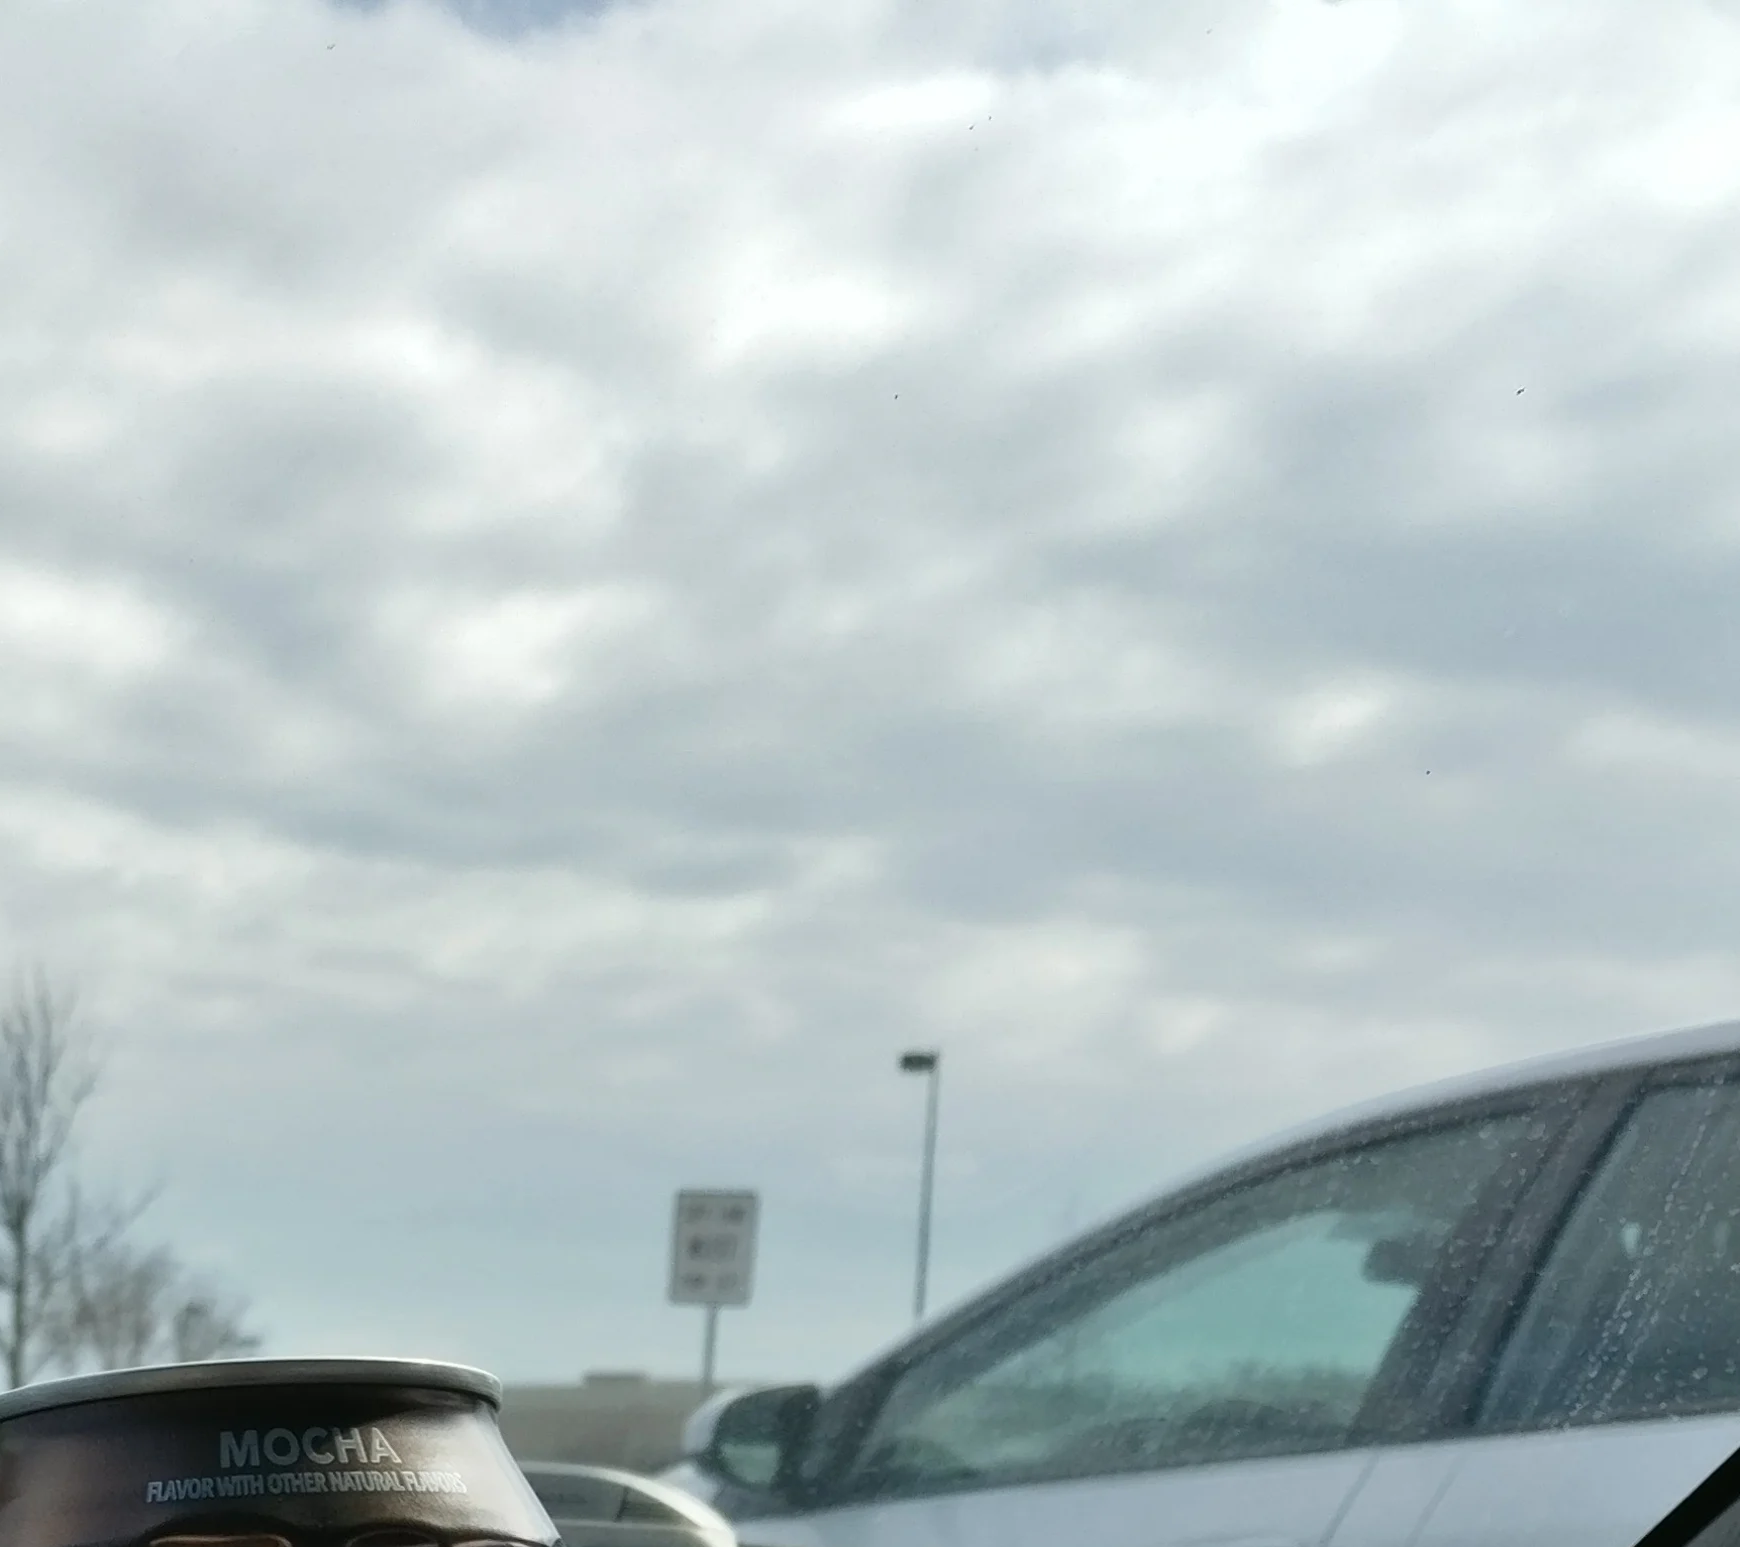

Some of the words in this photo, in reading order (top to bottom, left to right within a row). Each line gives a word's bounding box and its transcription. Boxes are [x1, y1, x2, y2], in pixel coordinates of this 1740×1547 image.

[220, 1427, 402, 1469] MOCHA
[146, 1478, 216, 1503] FLAVOR
[216, 1475, 261, 1498] WITH
[271, 1472, 330, 1495] OTHER
[331, 1470, 402, 1493] NATURAL
